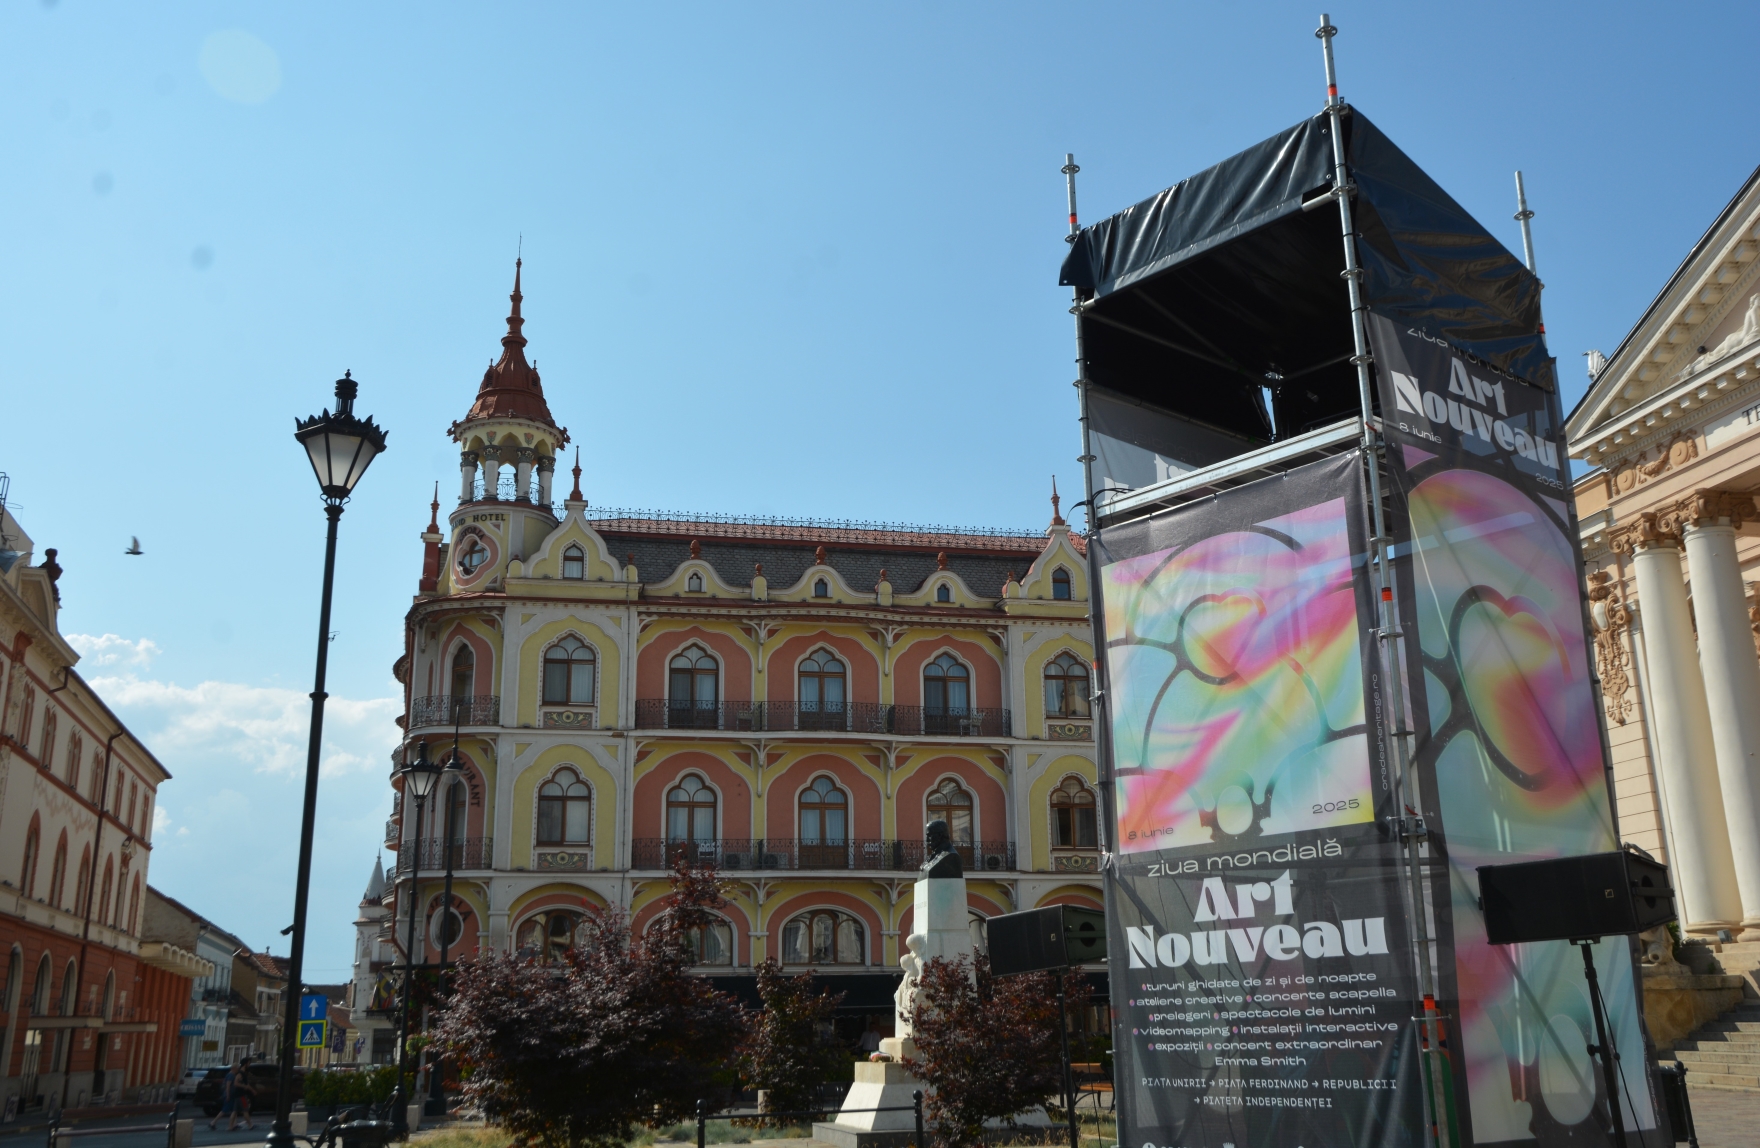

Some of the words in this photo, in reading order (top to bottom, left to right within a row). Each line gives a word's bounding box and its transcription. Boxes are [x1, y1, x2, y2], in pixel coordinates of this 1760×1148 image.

[1448, 356, 1508, 417] Art
[1390, 370, 1560, 471] Nouveau
[1400, 422, 1409, 433] 8
[1412, 425, 1442, 444] iunie
[1535, 473, 1564, 490] 2025
[472, 513, 506, 523] HOTEL
[1372, 673, 1388, 791] oradeaheritage.ro
[1312, 798, 1360, 815] 2025
[1127, 831, 1137, 840] 8
[1140, 825, 1174, 839] iunie
[1147, 859, 1199, 877] ziua
[1207, 838, 1343, 871] mondială
[1193, 869, 1295, 923] Art
[1125, 917, 1389, 969] Nouveau
[1146, 980, 1185, 991] tururi
[1188, 979, 1240, 992] ghidate
[1243, 977, 1262, 987] de
[1265, 976, 1276, 986] zi
[1279, 975, 1291, 988] și
[1295, 974, 1315, 984] de
[1318, 972, 1377, 984] noapte
[1136, 996, 1183, 1006] ateliere
[1185, 994, 1243, 1005] creative
[1253, 991, 1325, 1002] concerte
[1329, 987, 1397, 1000] acapella
[1153, 1010, 1211, 1022] prelegeri
[1220, 1006, 1301, 1020] spectacole
[1304, 1006, 1325, 1016] de
[1328, 1004, 1376, 1015] lumini
[1140, 1025, 1231, 1037] videomapping
[1240, 1023, 1302, 1036] instalații
[1305, 1021, 1398, 1032] interactive
[1155, 1041, 1204, 1053] expoziții
[1214, 1041, 1272, 1051] concert
[1275, 1039, 1383, 1049] extraordinar
[1215, 1057, 1258, 1066] Emma
[1261, 1055, 1307, 1066] Smith
[1172, 1078, 1207, 1088] UNIRII
[1250, 1079, 1309, 1089] FERDINAND
[1323, 1080, 1397, 1089] REPUBLICII
